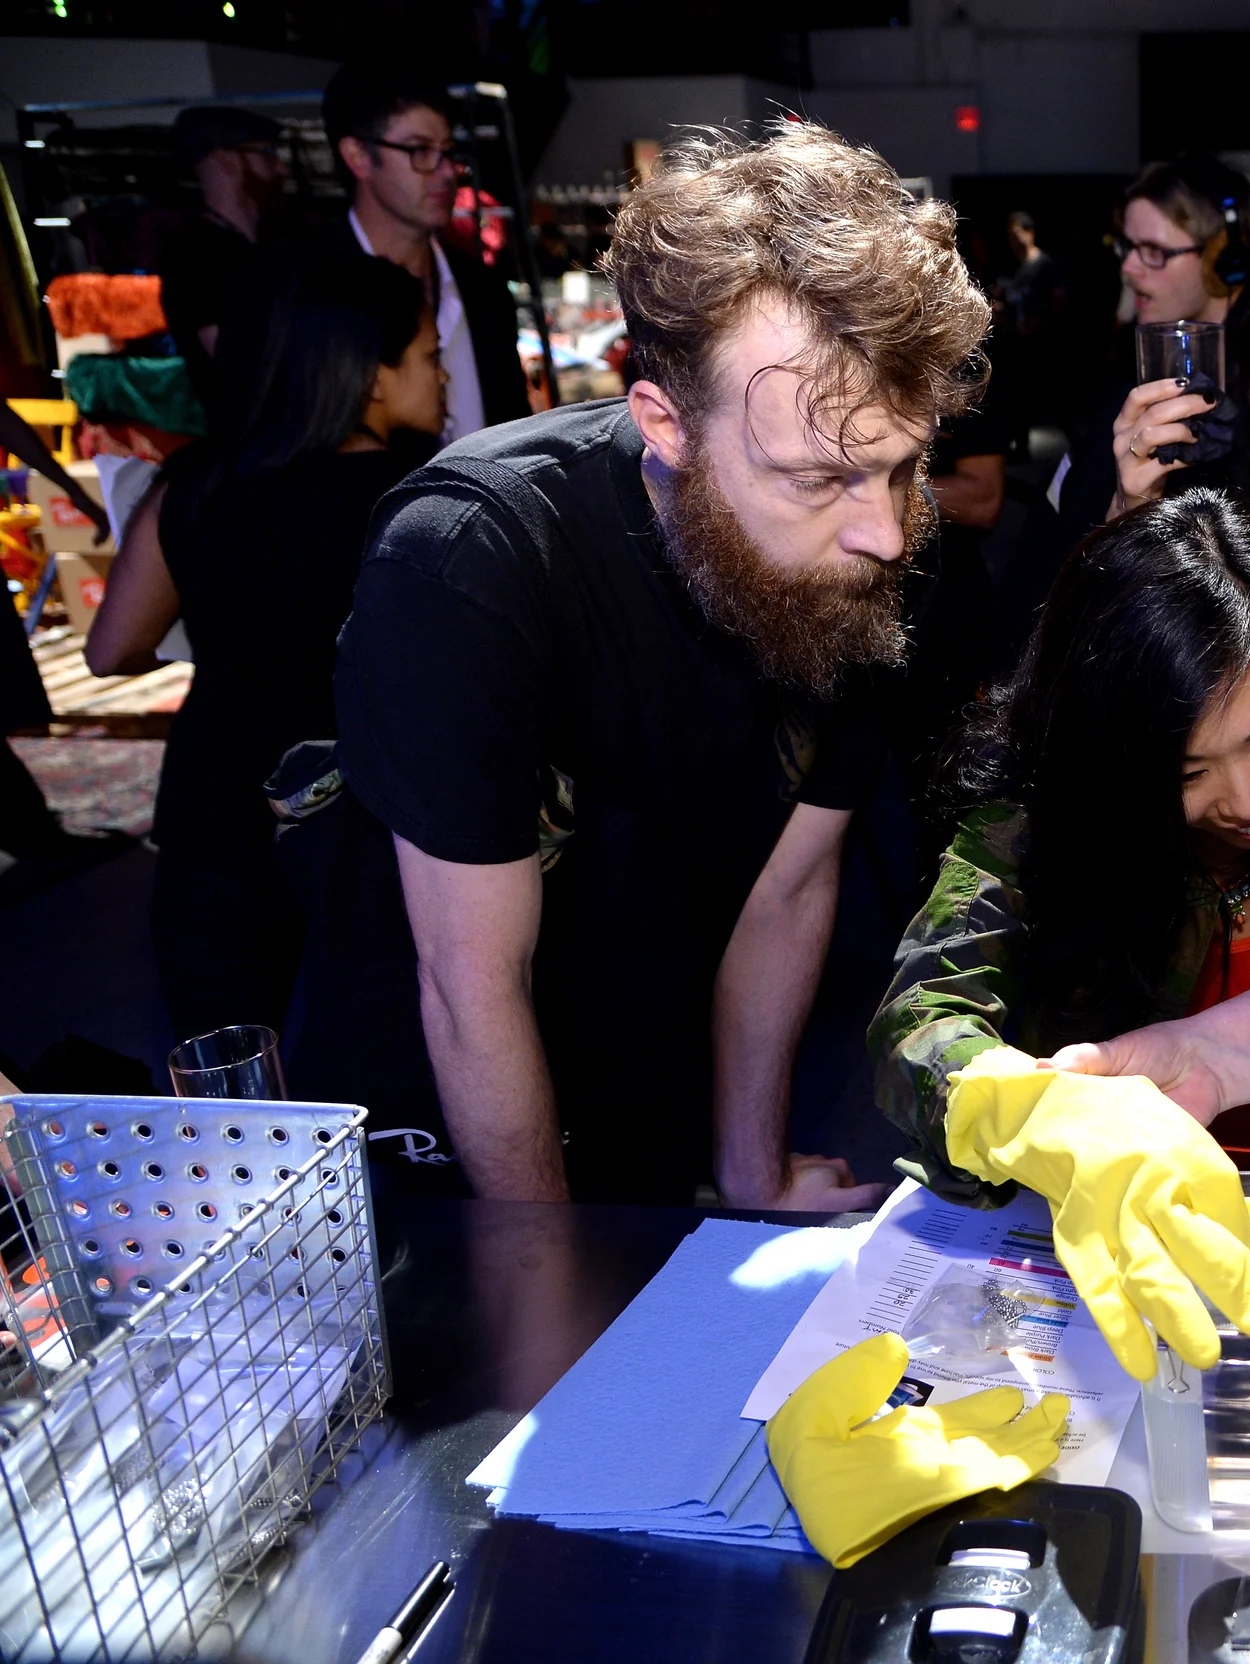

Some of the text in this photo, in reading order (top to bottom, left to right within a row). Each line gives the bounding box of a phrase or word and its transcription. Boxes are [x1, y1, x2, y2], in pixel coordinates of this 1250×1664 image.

[368, 1128, 453, 1166] Ra
[1056, 1294, 1078, 1302] Orange
[859, 1319, 886, 1331] Numbers
[1025, 1331, 1046, 1339] Purple
[835, 1342, 851, 1350] uture
